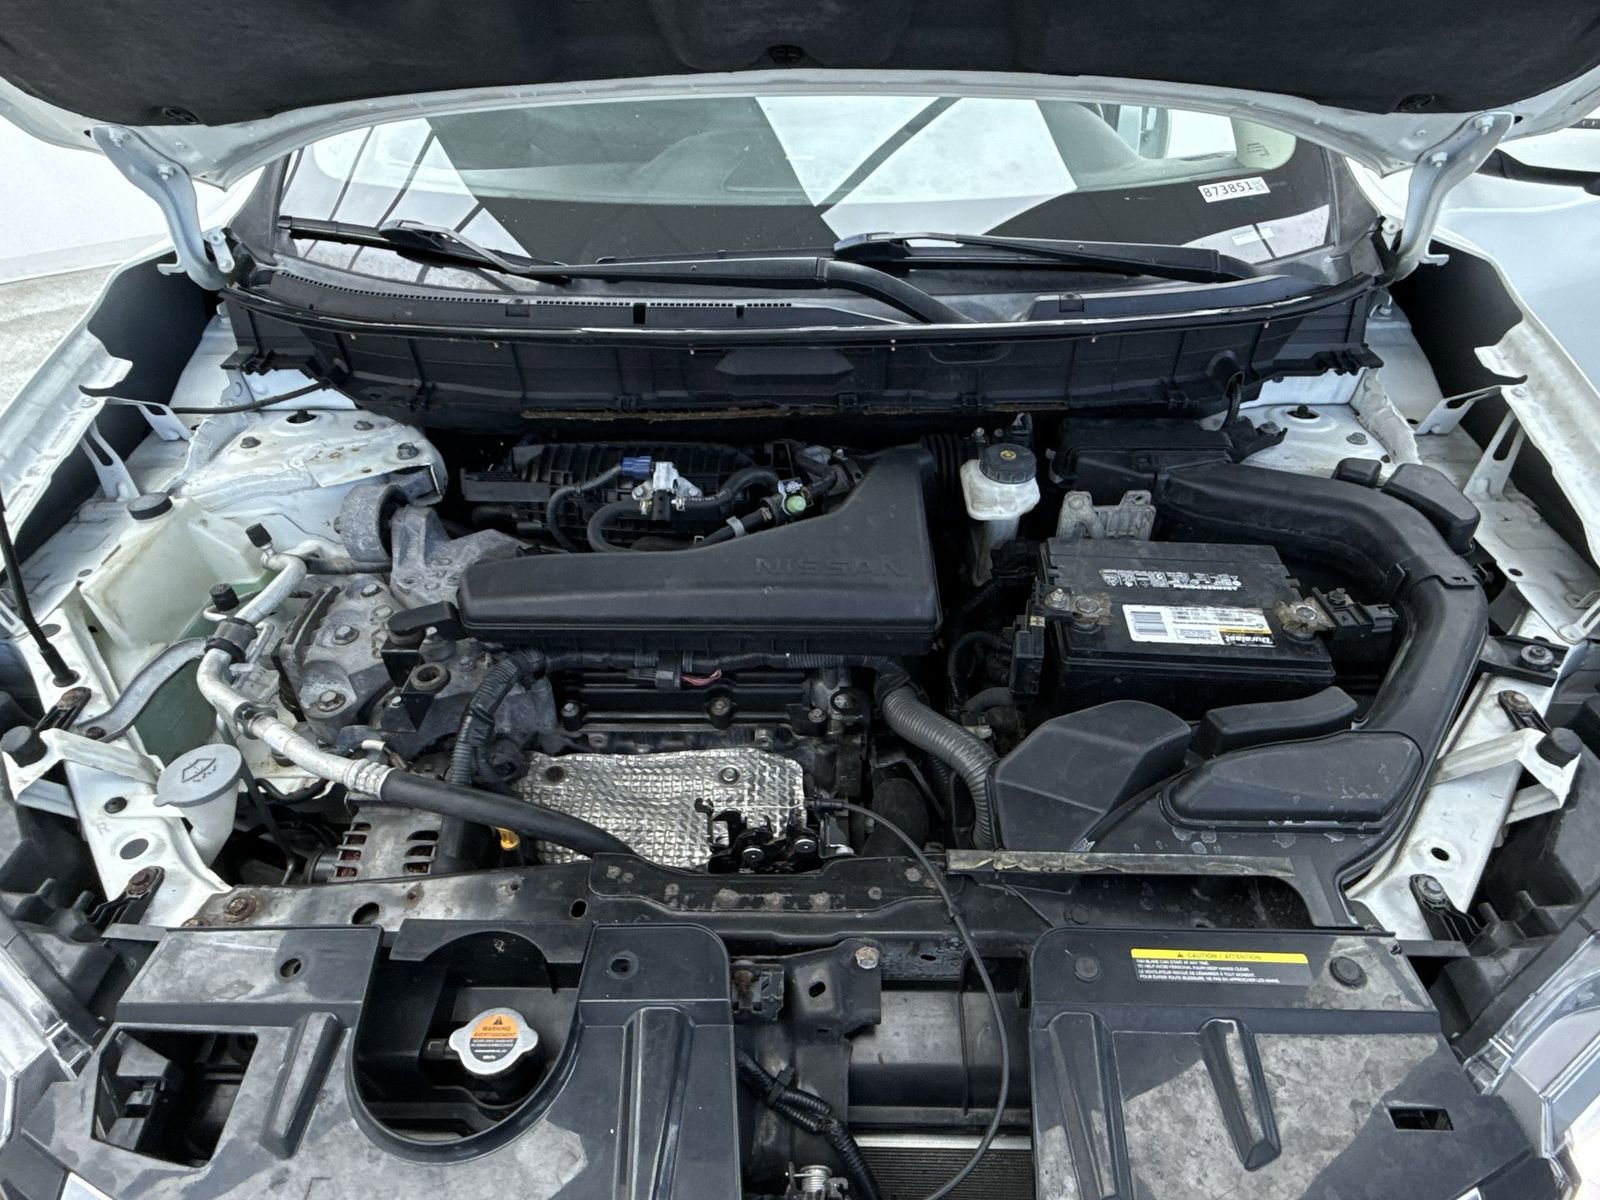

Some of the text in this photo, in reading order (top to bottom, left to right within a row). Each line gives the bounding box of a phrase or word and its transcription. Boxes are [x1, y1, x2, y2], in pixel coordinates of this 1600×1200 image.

[1202, 181, 1254, 198] 873851
[754, 557, 908, 578] NISSAN
[1224, 634, 1274, 645] Duralast
